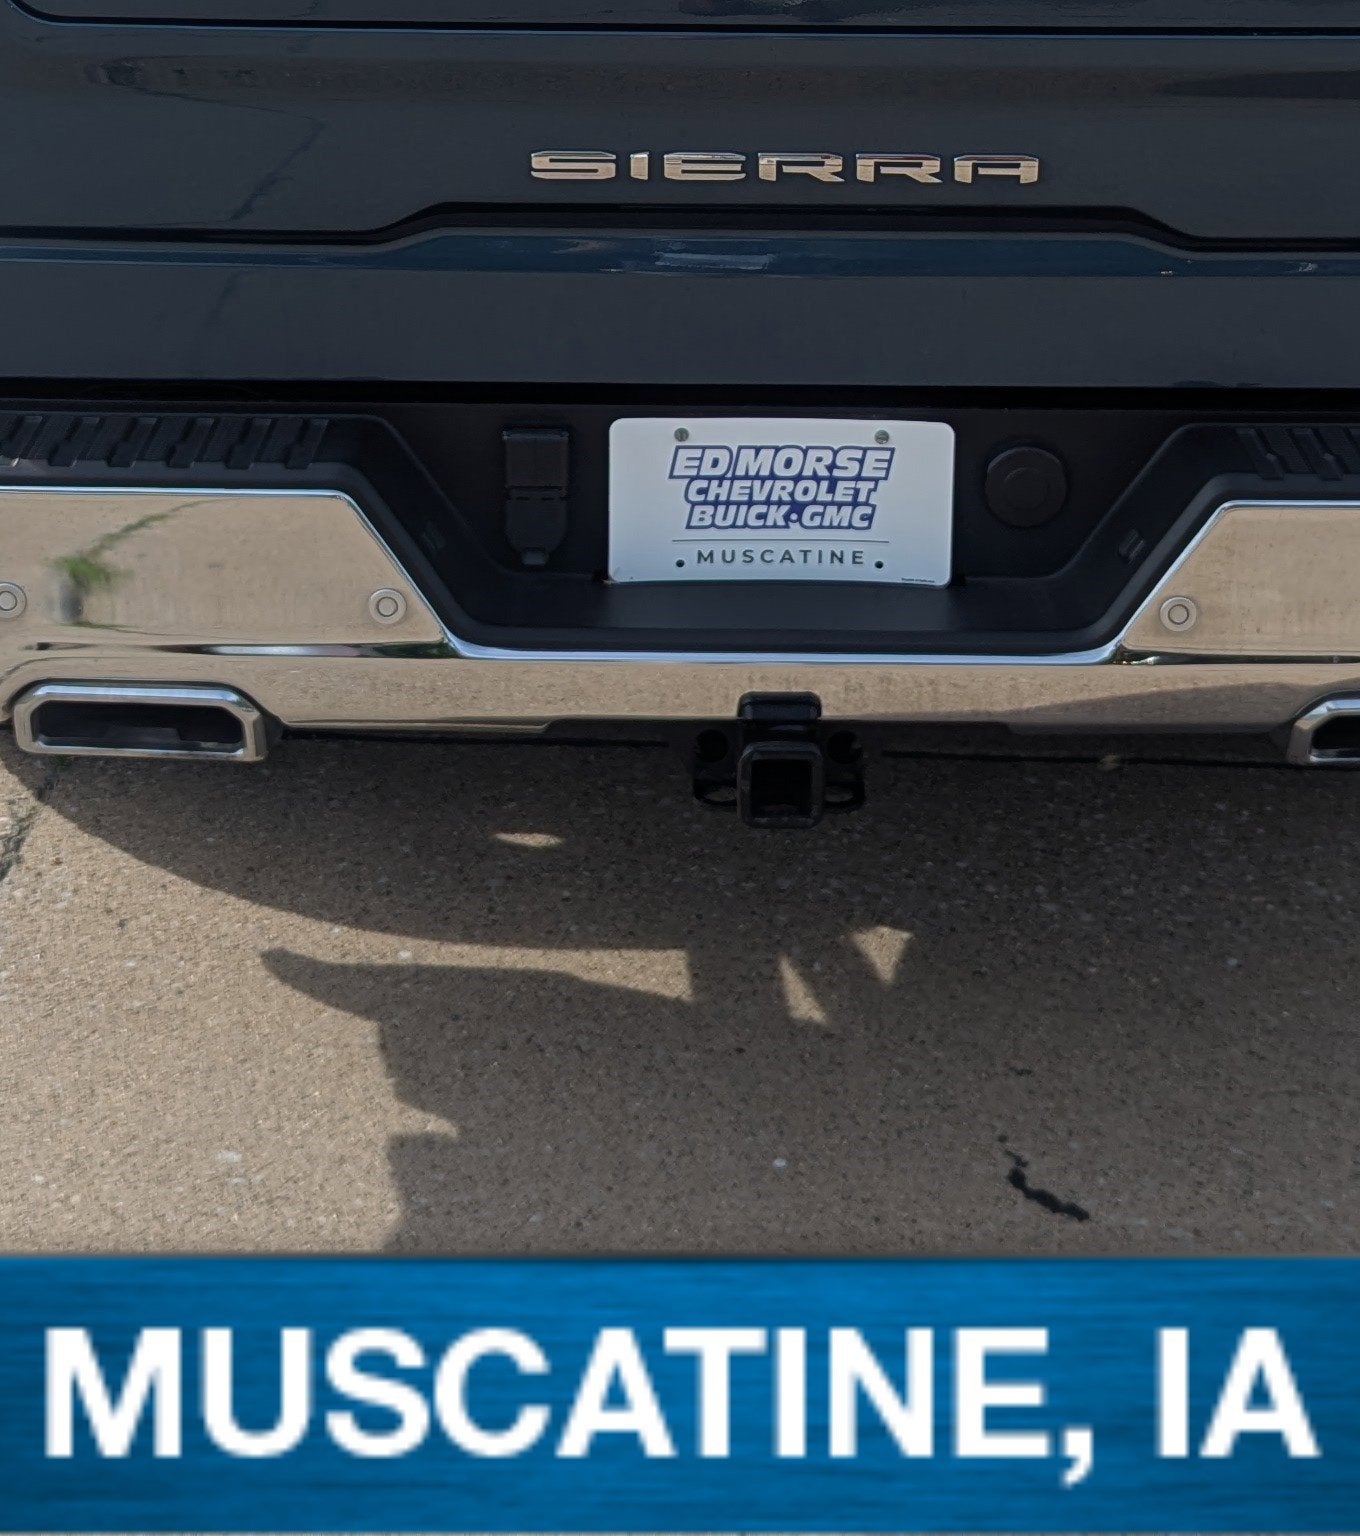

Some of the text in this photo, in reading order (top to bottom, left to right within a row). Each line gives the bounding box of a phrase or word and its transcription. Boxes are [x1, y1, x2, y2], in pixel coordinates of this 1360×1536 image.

[530, 150, 1040, 184] SIERRA
[668, 445, 895, 480] ED MORSE
[684, 478, 877, 504] CHEVROLET
[696, 549, 865, 565] MUSCATINE
